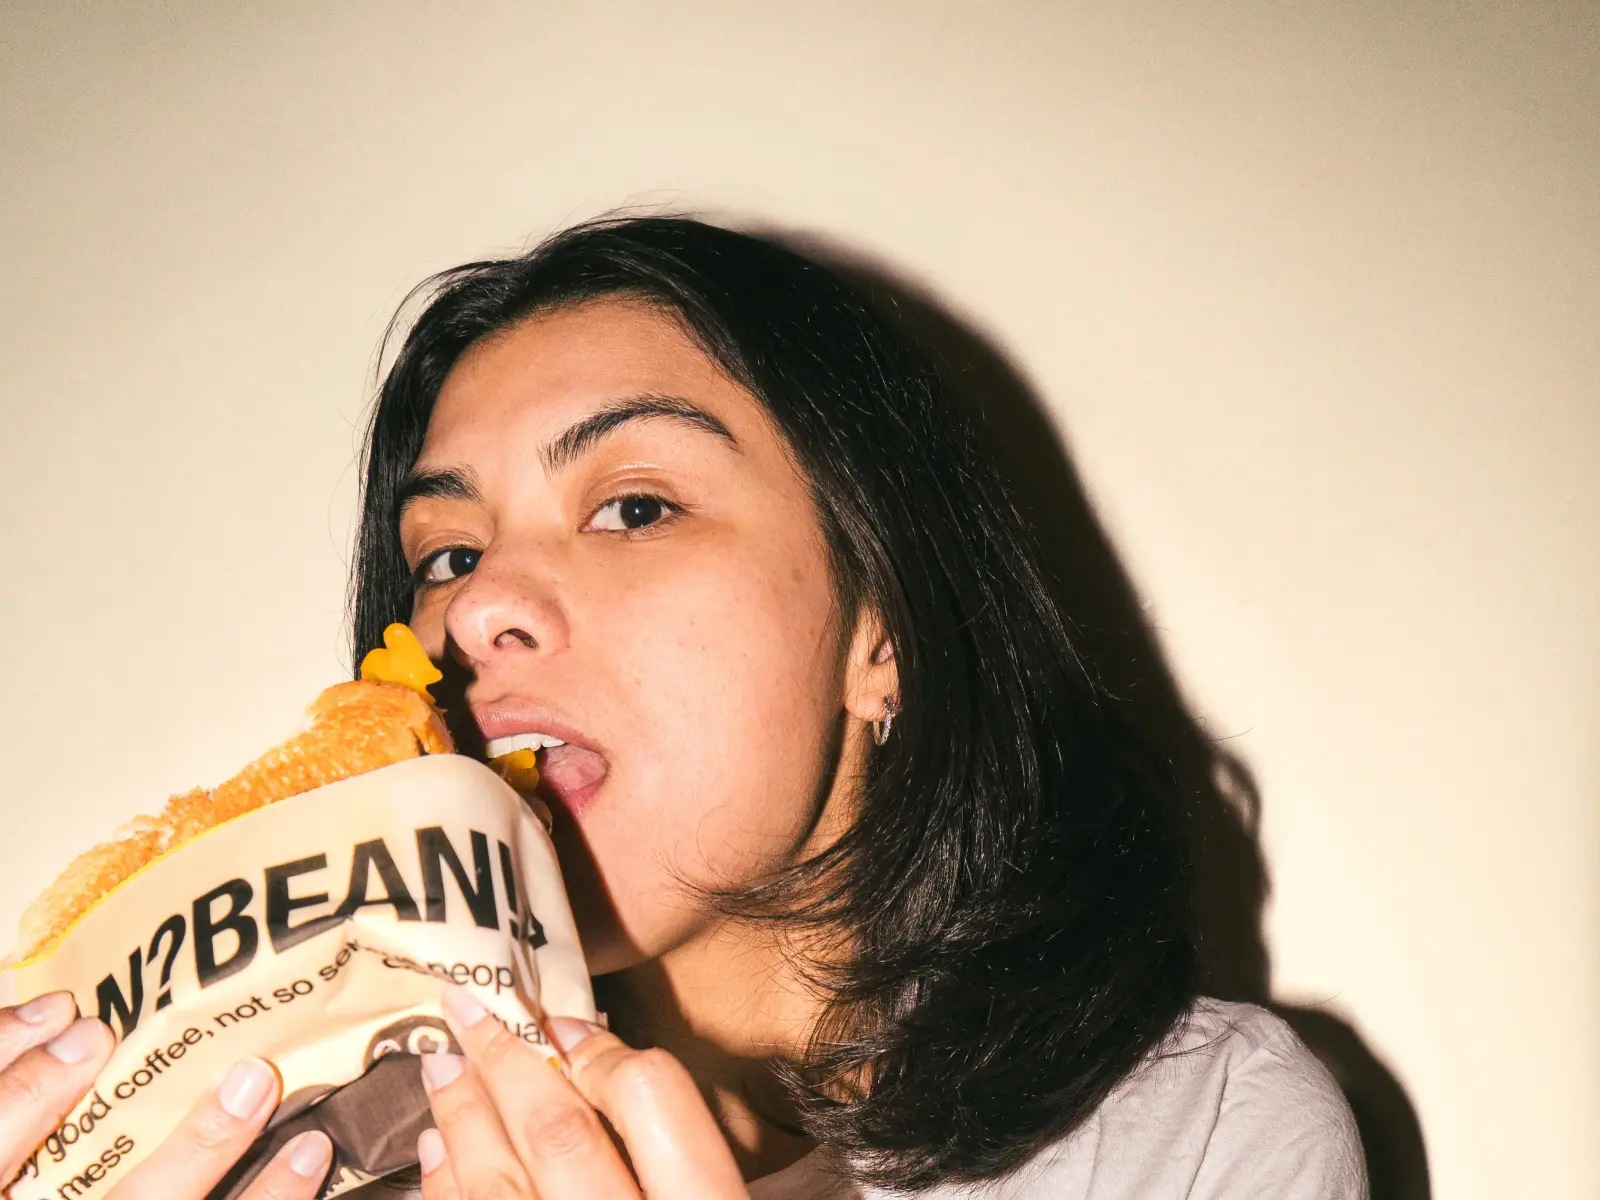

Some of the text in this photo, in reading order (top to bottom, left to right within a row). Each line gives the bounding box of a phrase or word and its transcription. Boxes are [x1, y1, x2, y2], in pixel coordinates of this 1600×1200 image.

[45, 1090, 112, 1162] good
[114, 1026, 215, 1100] coffee,
[213, 995, 271, 1028] not
[273, 979, 313, 1004] so
